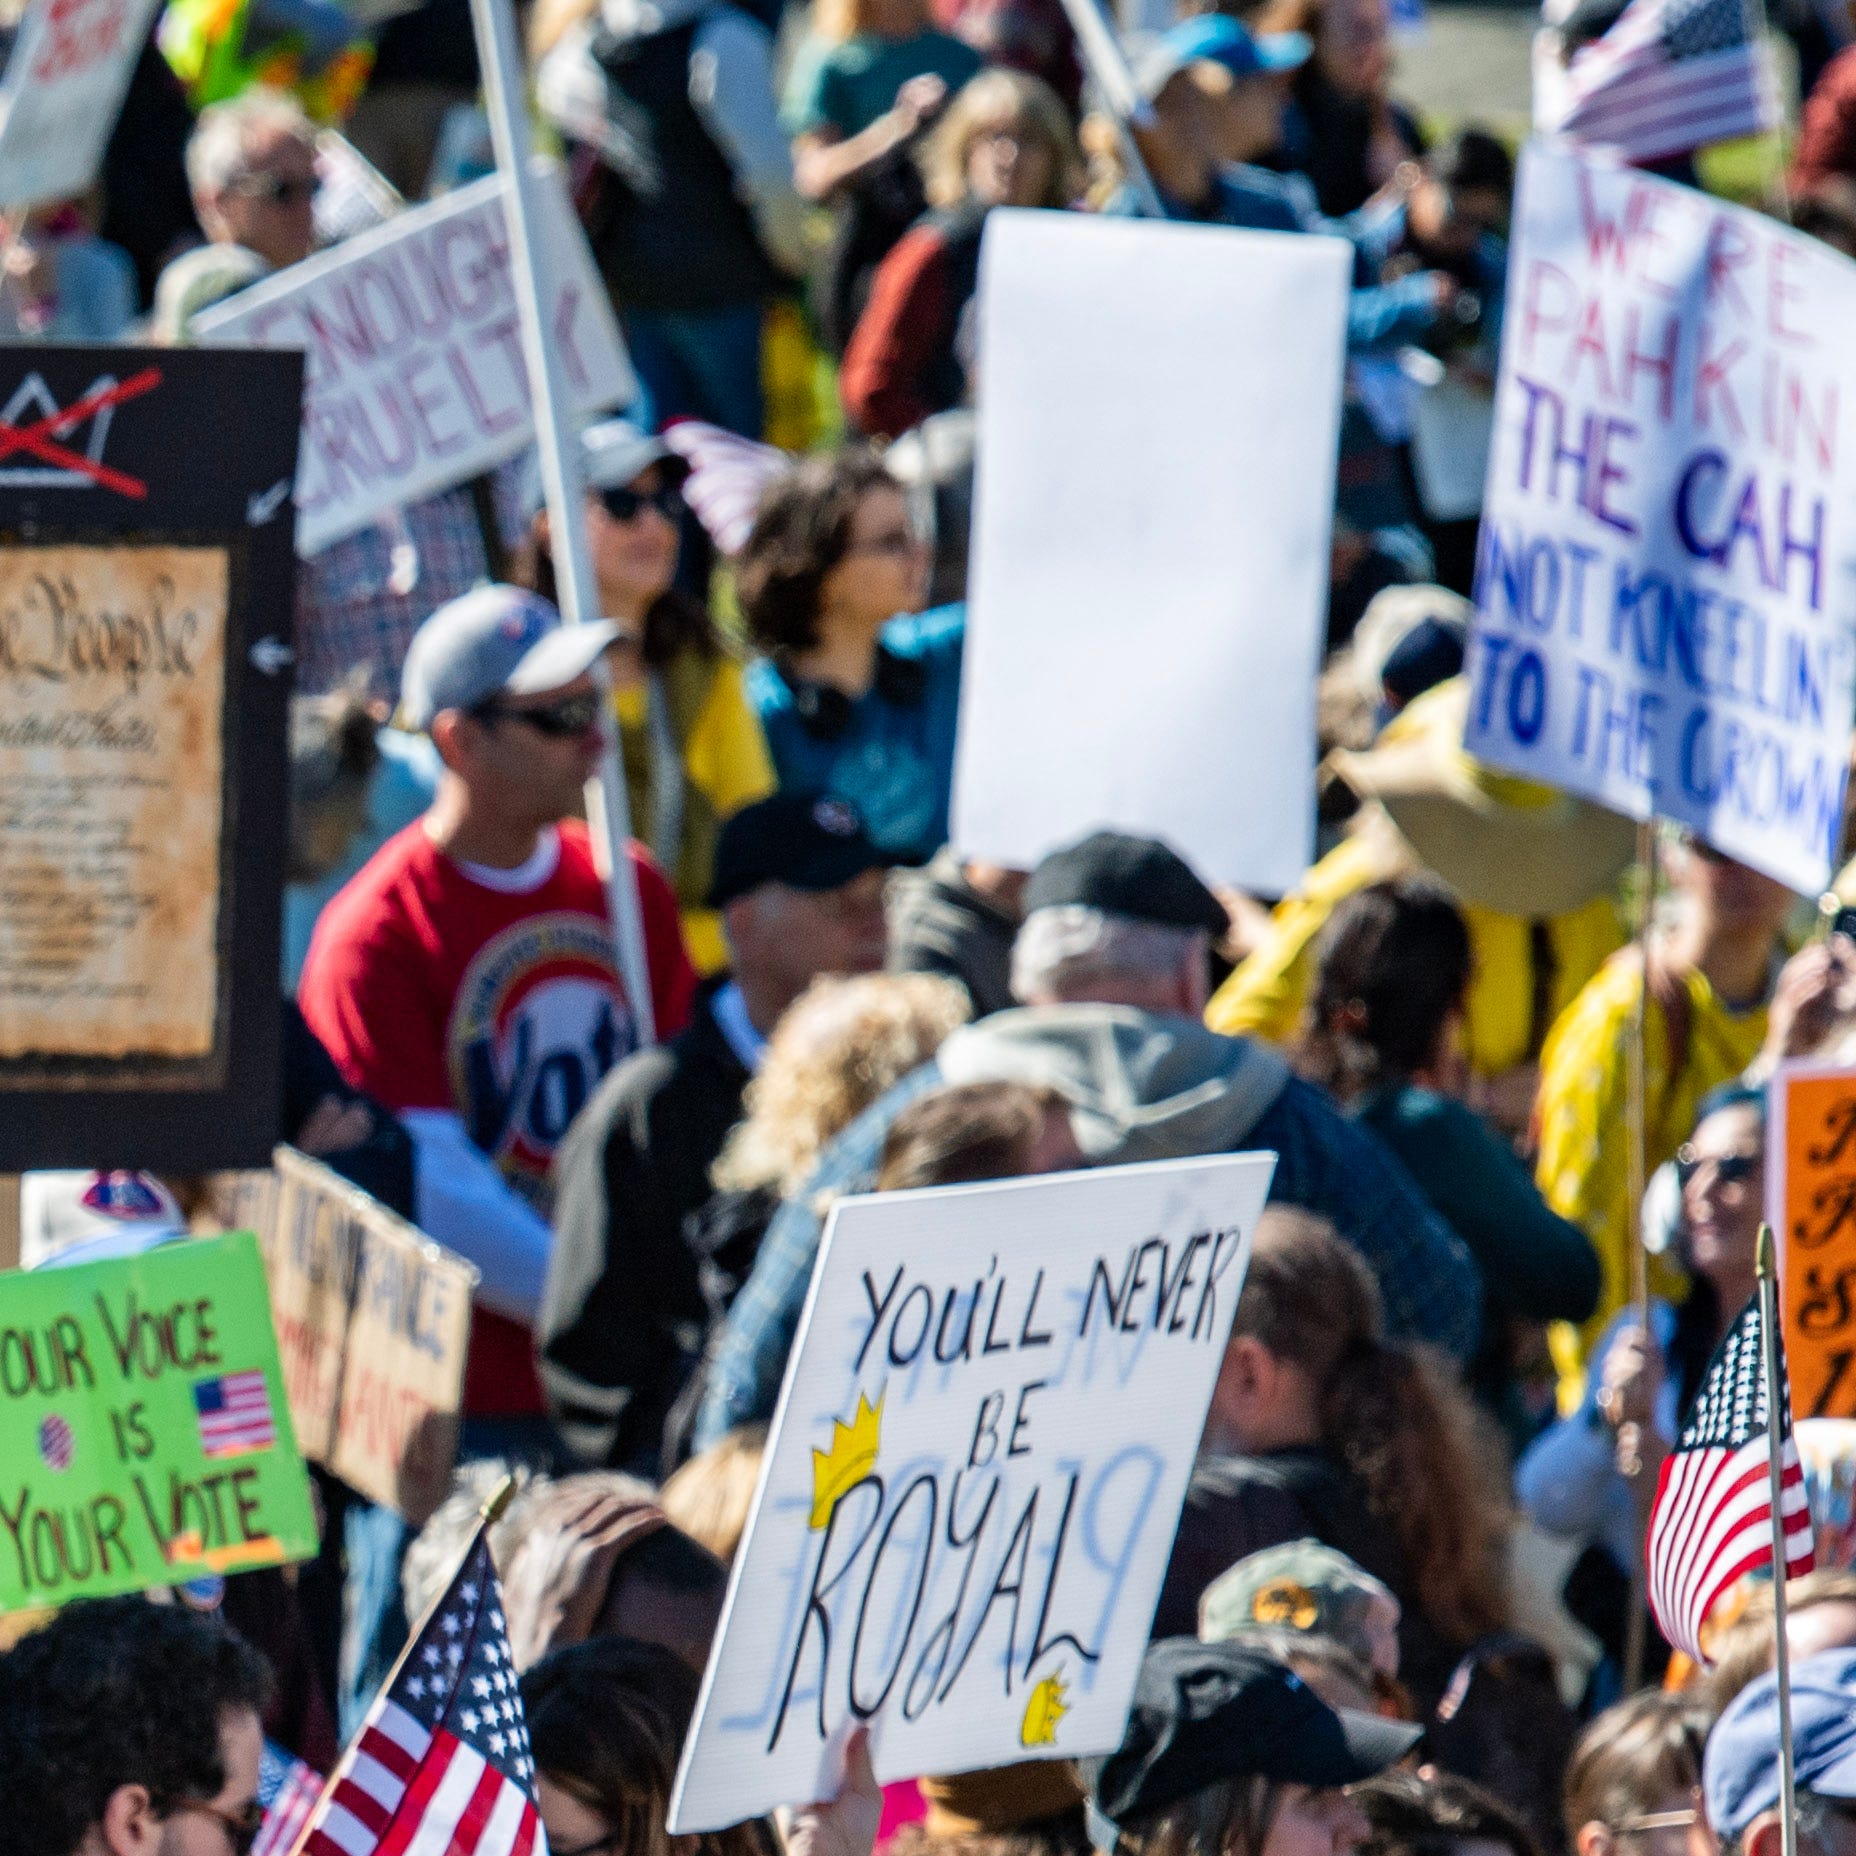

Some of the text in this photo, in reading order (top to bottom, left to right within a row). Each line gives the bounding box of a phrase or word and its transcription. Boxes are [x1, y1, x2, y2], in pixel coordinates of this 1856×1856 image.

[1514, 374, 1828, 612] THE CAH
[1478, 524, 1602, 640] NOT
[1476, 630, 1548, 748] TO
[95, 1290, 222, 1381] VOICE
[854, 1224, 1242, 1375] YOU'LL NEVER
[110, 1400, 155, 1463] IS
[968, 1379, 1048, 1473] BE
[132, 1467, 270, 1566] VOTE
[767, 1468, 1100, 1755] ROYAL
